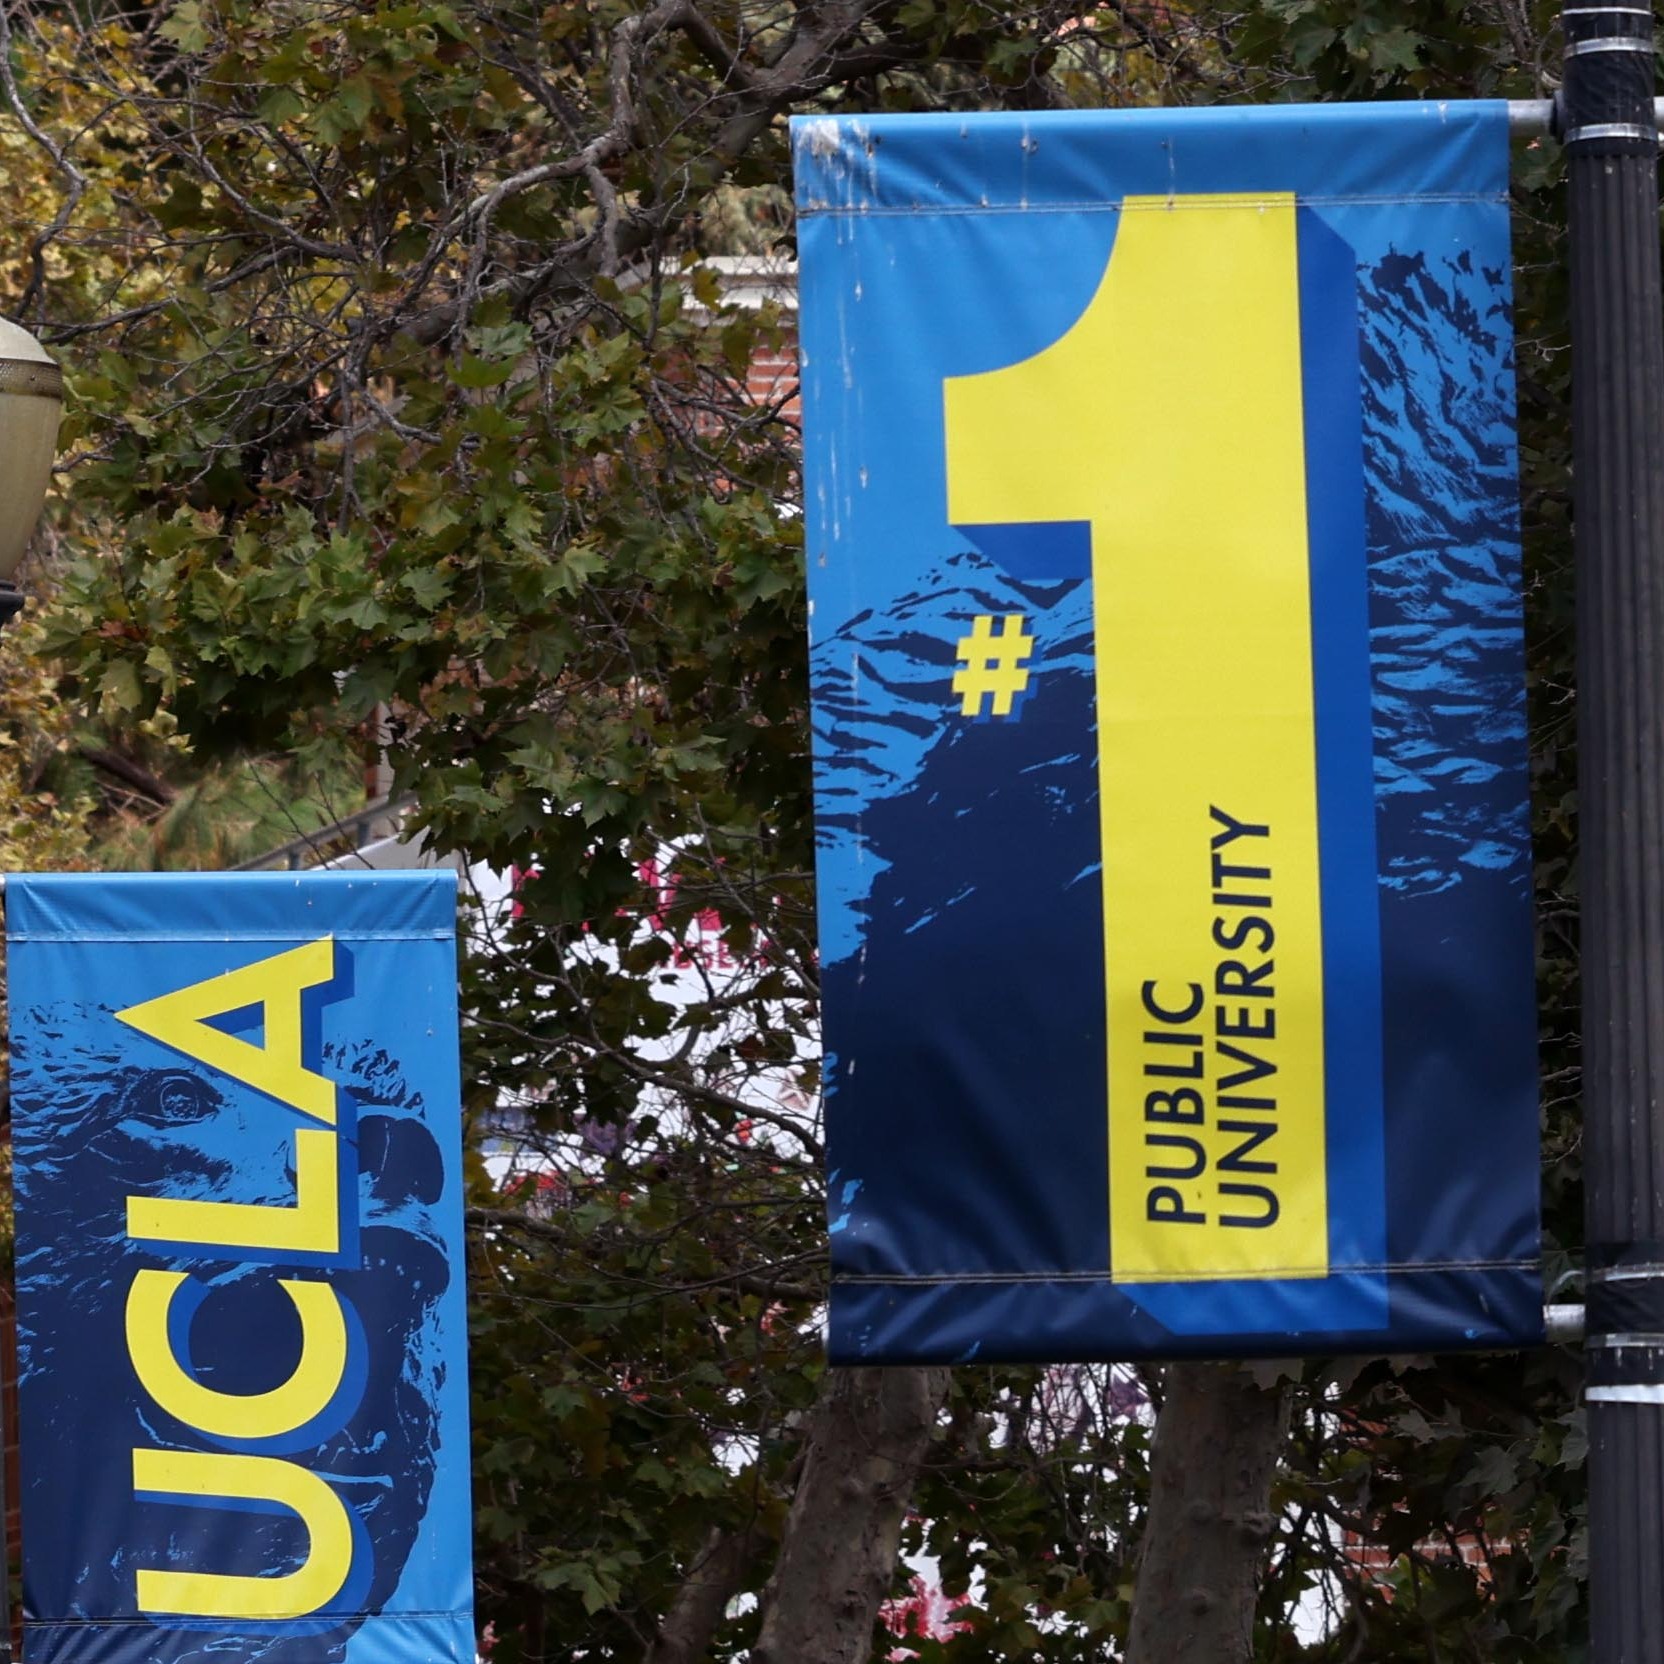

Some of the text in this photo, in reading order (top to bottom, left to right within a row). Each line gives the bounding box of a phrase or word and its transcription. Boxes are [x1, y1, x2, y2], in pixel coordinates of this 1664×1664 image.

[1140, 980, 1207, 1226] PUBLIC
[1209, 804, 1281, 1229] UNIVERSITY
[114, 933, 353, 1621] UCLA
